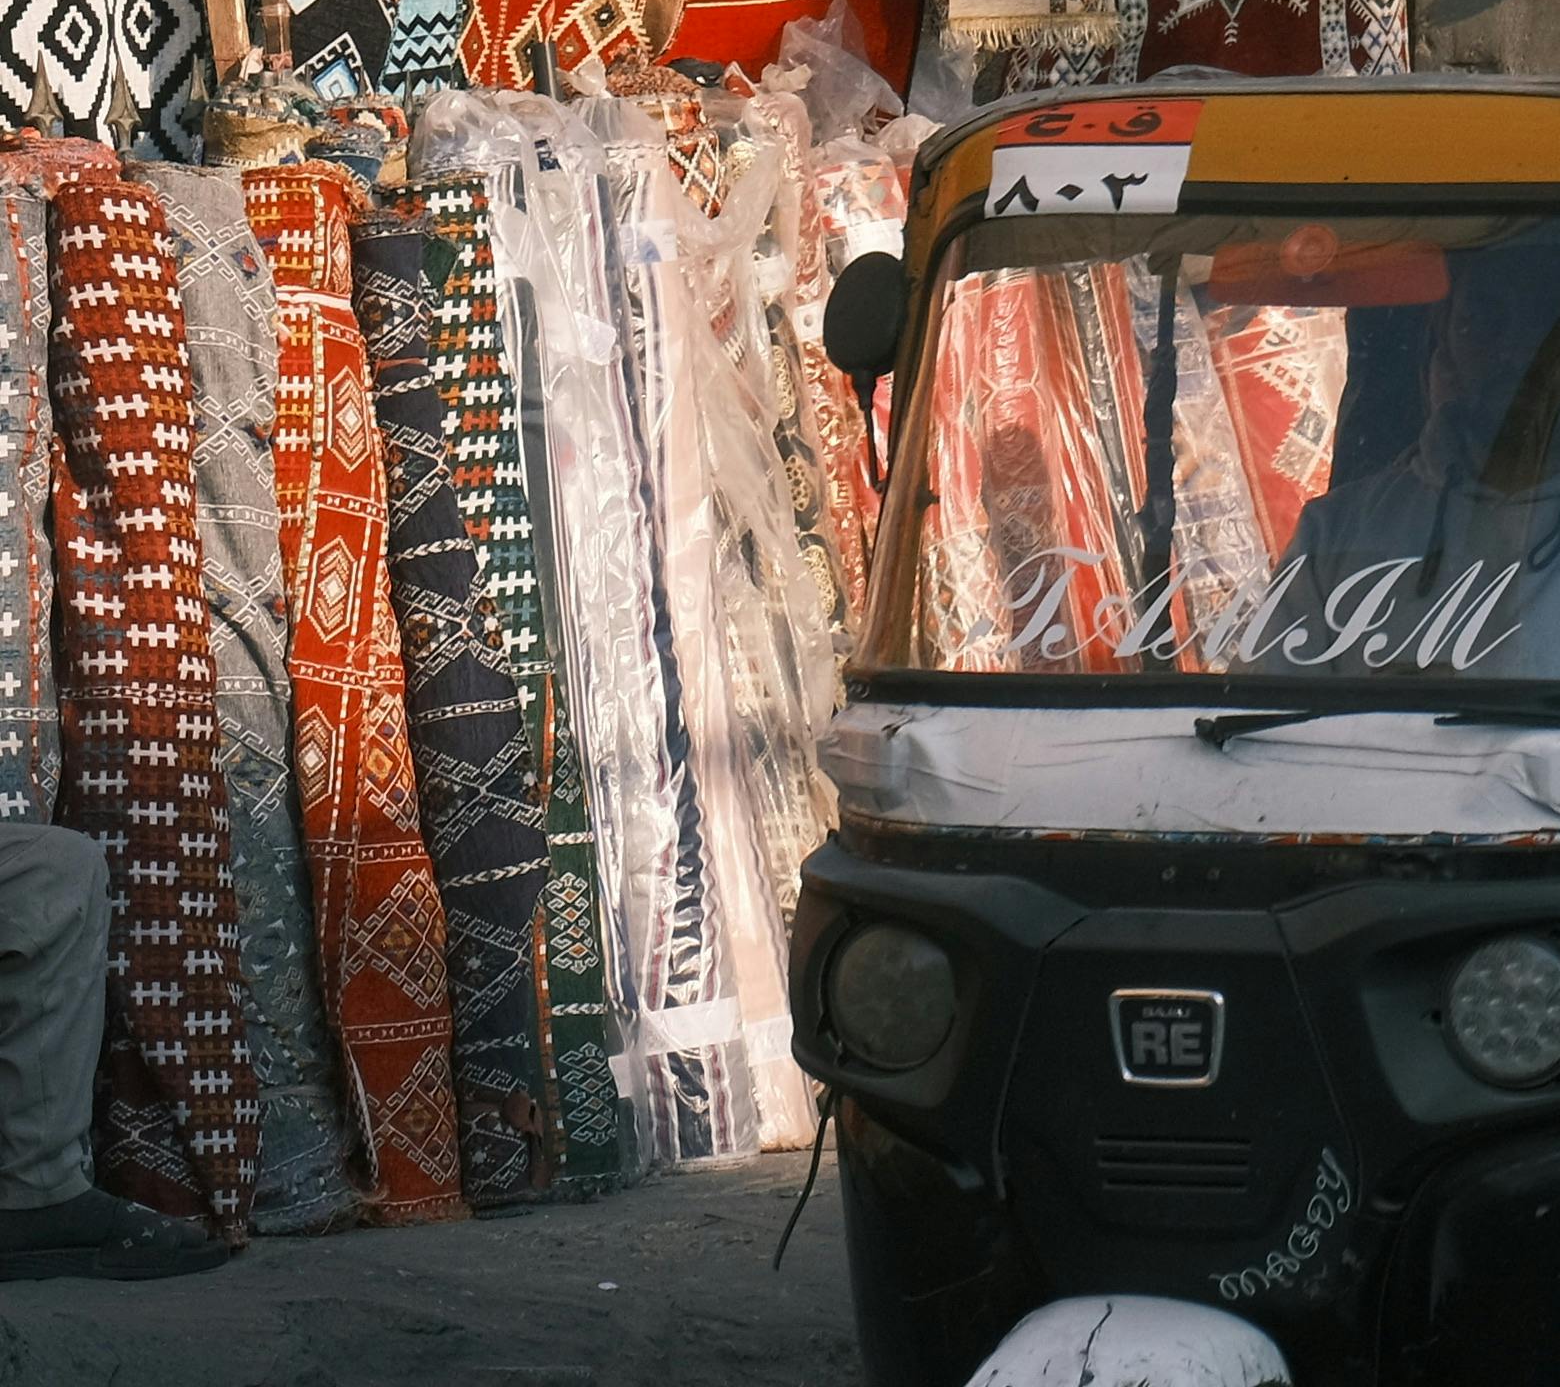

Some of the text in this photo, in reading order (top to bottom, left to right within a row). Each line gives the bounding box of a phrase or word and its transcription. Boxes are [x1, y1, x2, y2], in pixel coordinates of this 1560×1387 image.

[995, 171, 1150, 214] ٨٠٣
[966, 545, 1522, 671] TAMIM
[1131, 1021, 1206, 1066] RE
[1208, 1147, 1352, 1301] MAGDY
